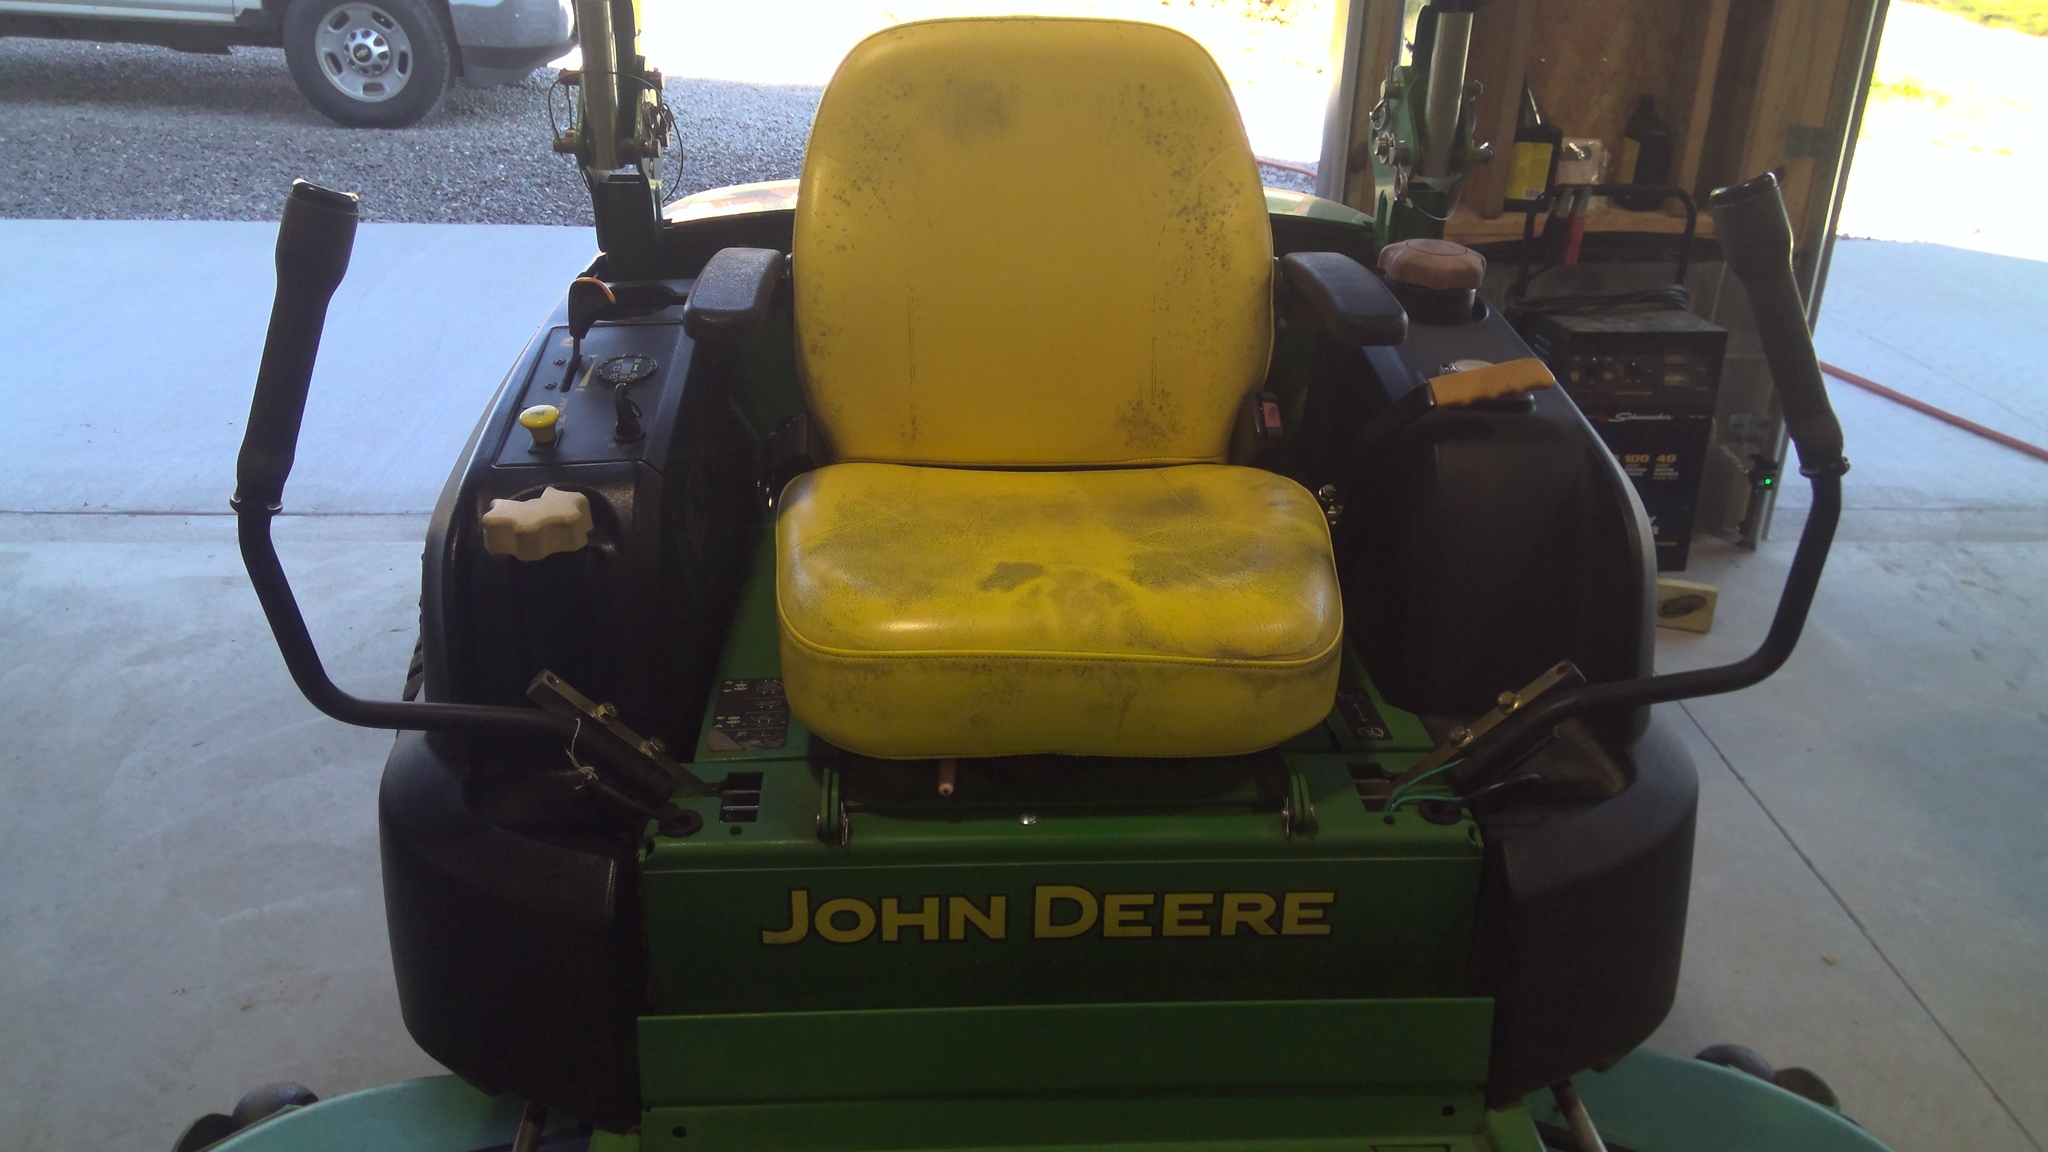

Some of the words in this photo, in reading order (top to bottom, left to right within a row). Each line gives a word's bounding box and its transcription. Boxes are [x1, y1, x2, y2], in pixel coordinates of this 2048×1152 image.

[1624, 453, 1650, 463] 100
[1656, 453, 1677, 463] 40
[761, 888, 1007, 945] JOHN
[1033, 883, 1336, 939] DEERE
